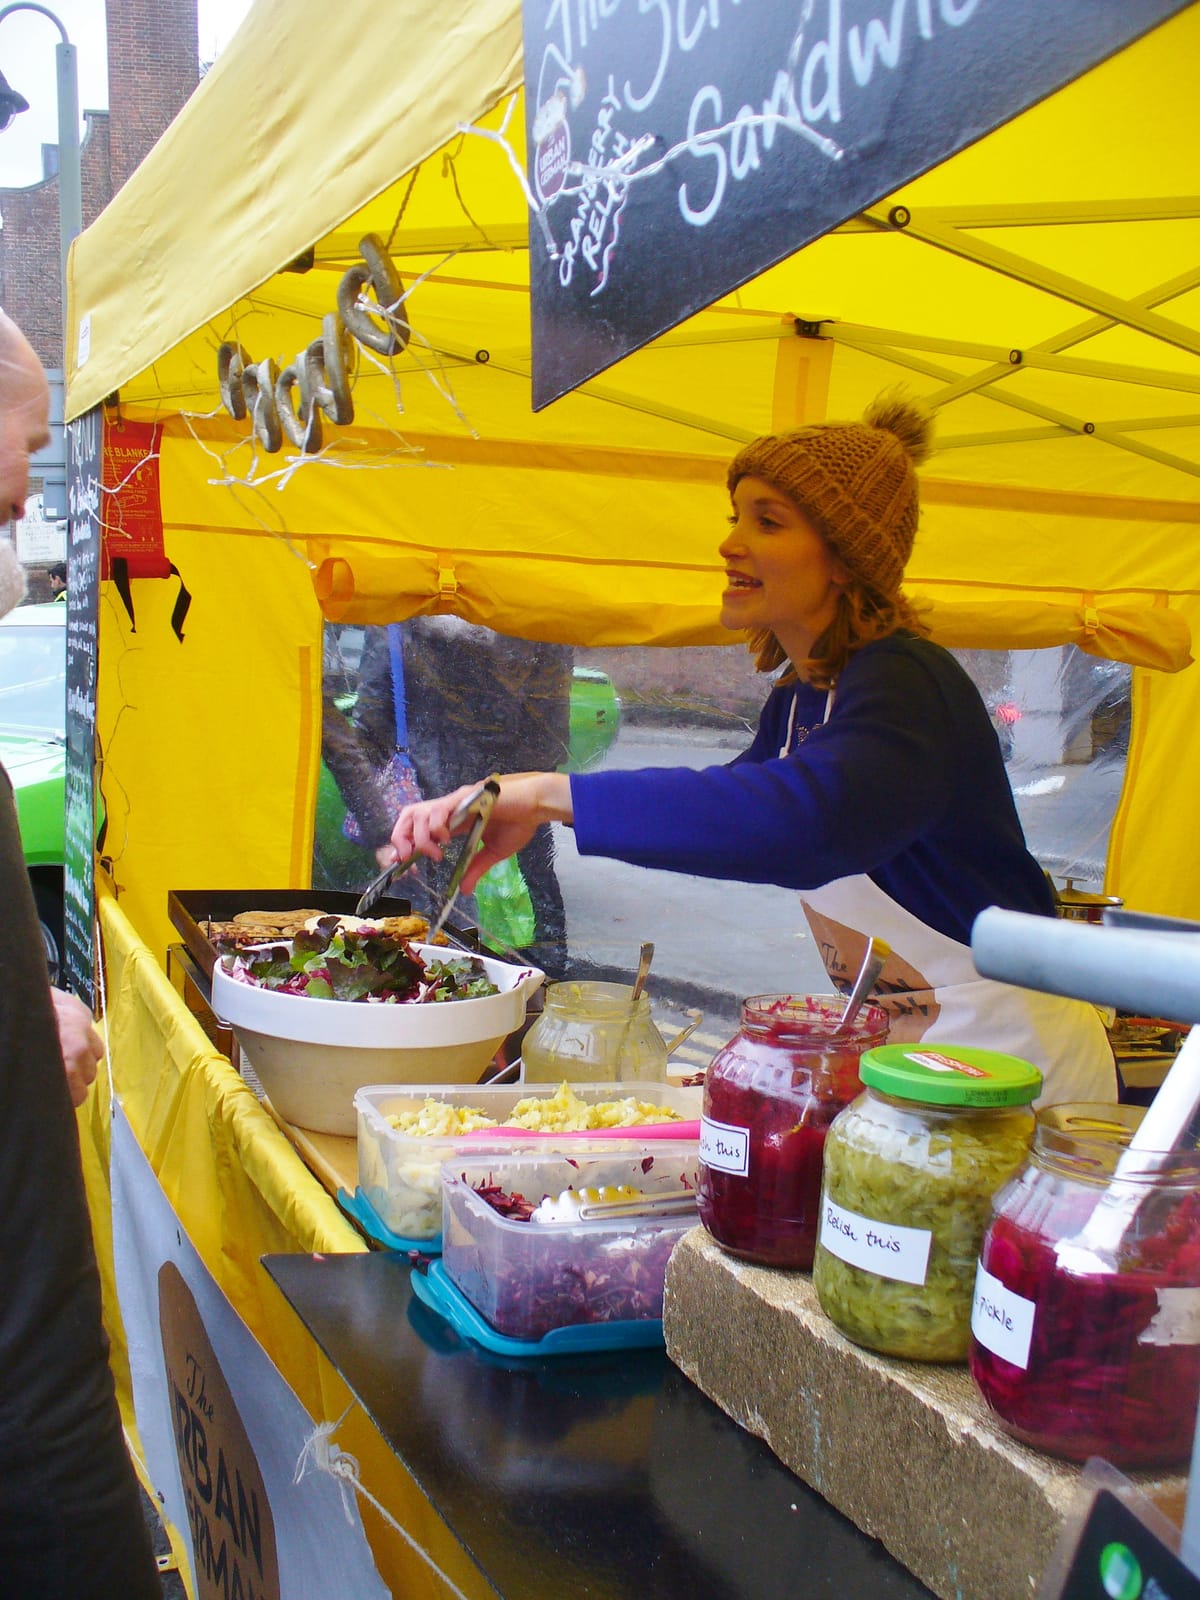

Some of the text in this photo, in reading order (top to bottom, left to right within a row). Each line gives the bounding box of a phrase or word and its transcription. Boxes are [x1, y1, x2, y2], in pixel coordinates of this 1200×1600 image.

[114, 447, 150, 458] BLANKE
[822, 943, 848, 973] The
[716, 1138, 741, 1158] this
[827, 1207, 901, 1253] Relish this
[186, 1355, 215, 1424] The
[172, 1378, 263, 1583] RBAN
